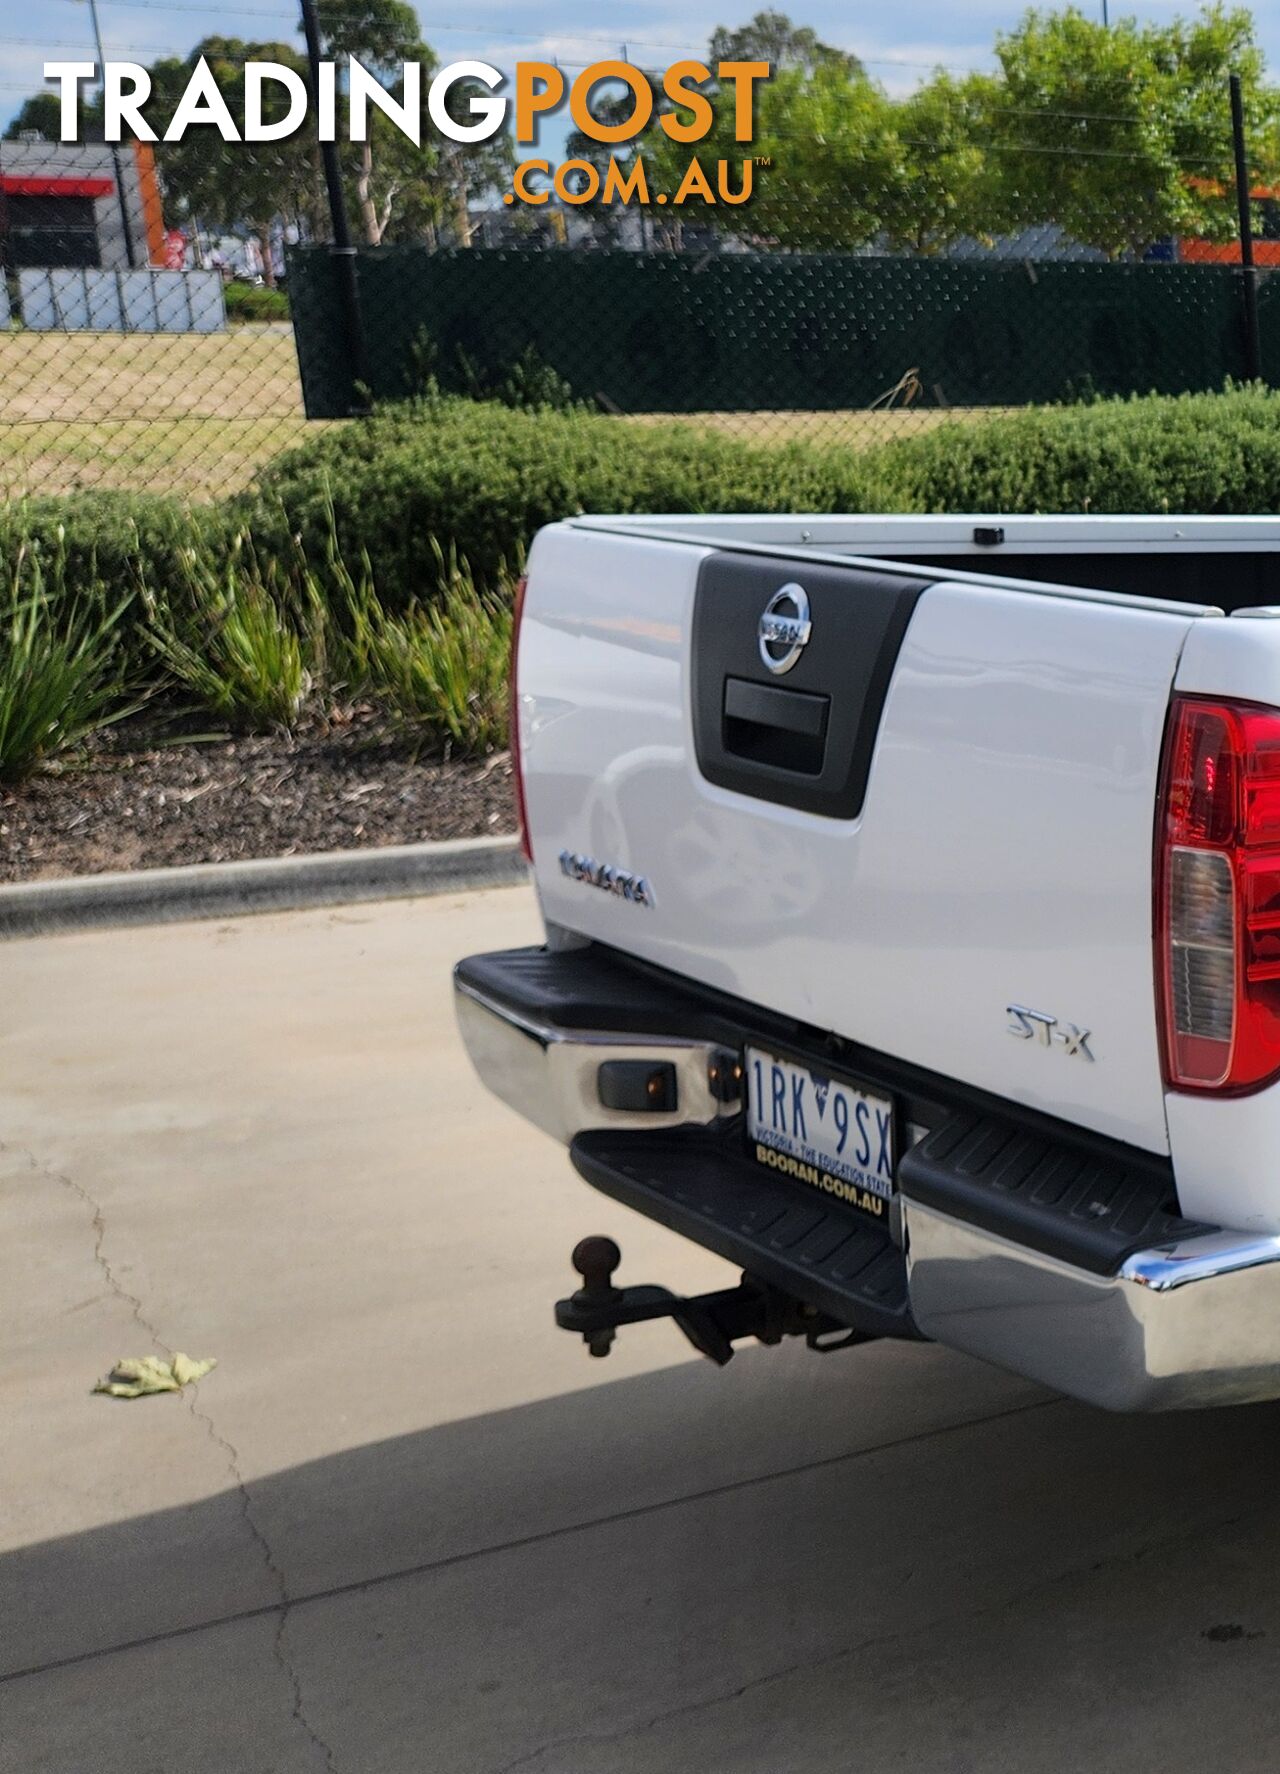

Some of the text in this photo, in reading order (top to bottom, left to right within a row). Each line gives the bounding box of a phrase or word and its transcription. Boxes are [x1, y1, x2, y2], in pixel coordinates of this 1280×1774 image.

[1006, 1003, 1096, 1063] ST-X
[755, 1060, 892, 1178] 1RK 9SX
[756, 1143, 883, 1217] BOORAN.COM.AU
